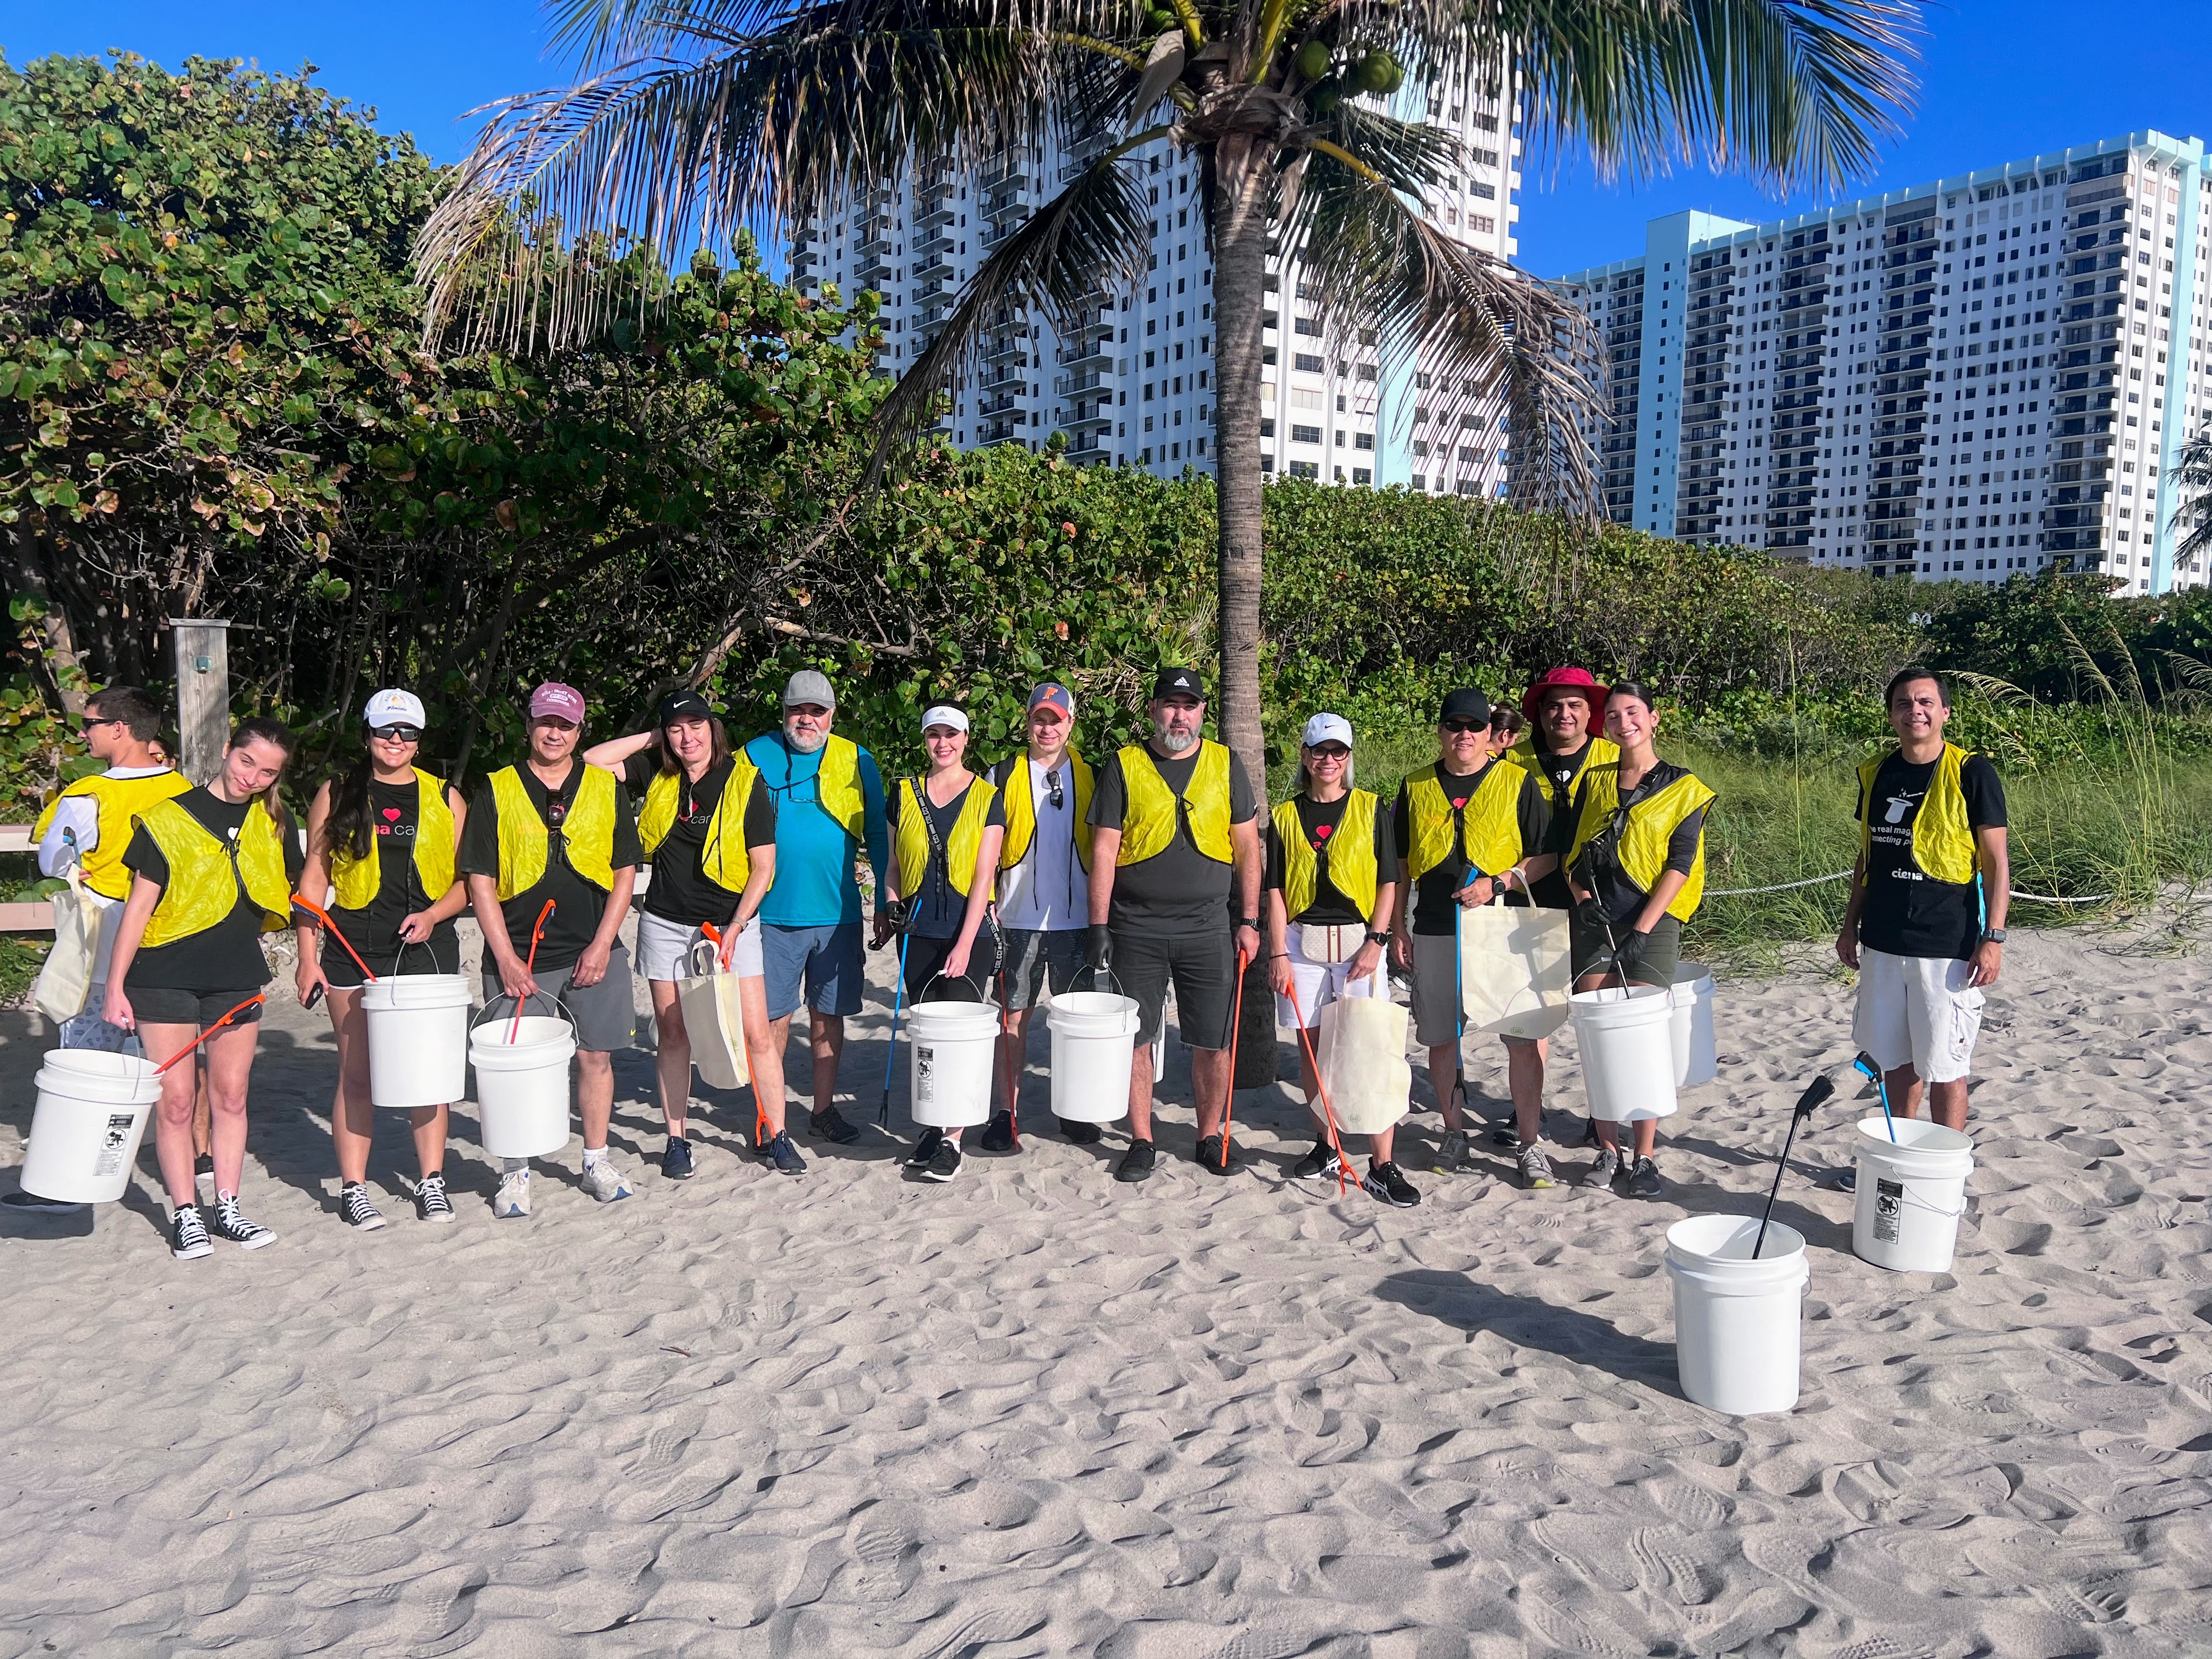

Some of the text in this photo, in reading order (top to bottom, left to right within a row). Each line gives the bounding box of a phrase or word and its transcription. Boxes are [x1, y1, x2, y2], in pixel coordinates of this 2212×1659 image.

[1042, 686, 1059, 699] F
[912, 781, 923, 798] COLCCI
[691, 815, 712, 824] car
[922, 806, 933, 824] COLCCI
[1894, 827, 1911, 836] mag
[1892, 868, 1923, 881] ciena
[994, 950, 1003, 969] COLCCI
